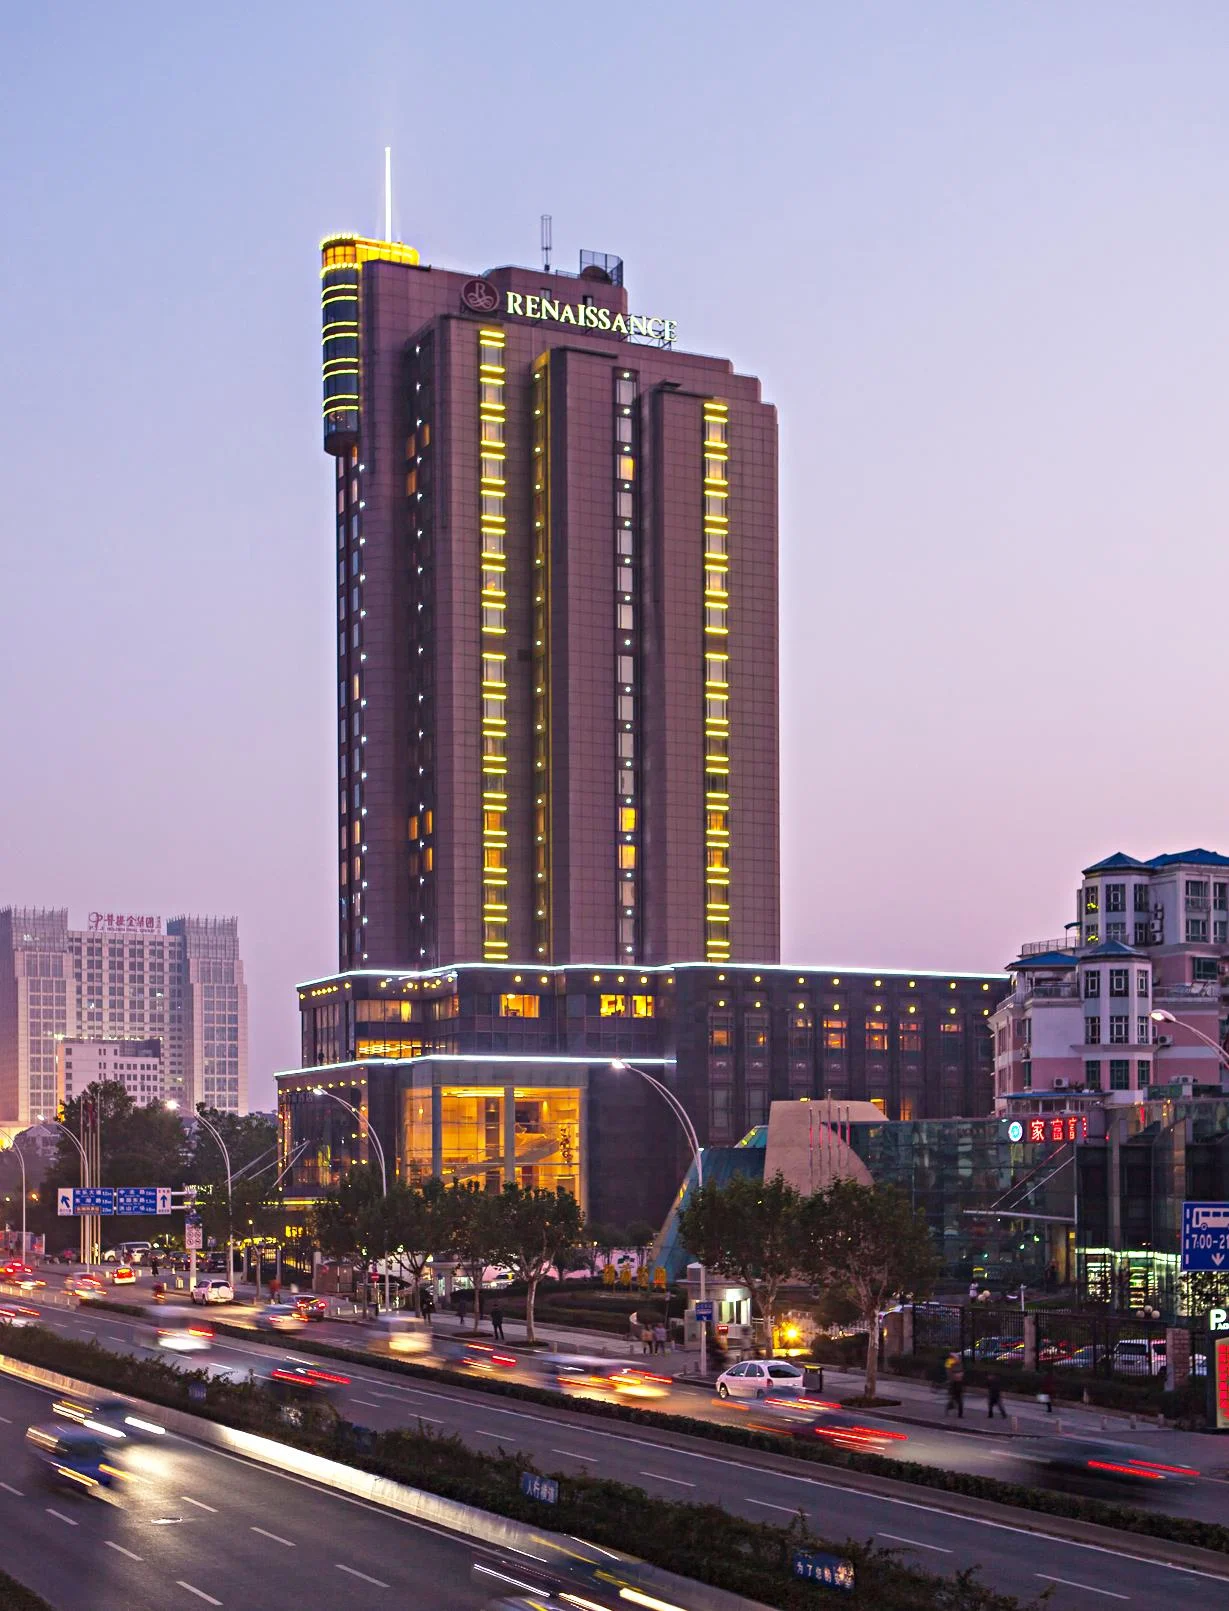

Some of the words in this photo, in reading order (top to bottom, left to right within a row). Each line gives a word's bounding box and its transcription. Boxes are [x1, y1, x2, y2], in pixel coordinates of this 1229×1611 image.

[506, 291, 679, 342] RENAISSANCE
[1031, 1117, 1087, 1141] 家富富
